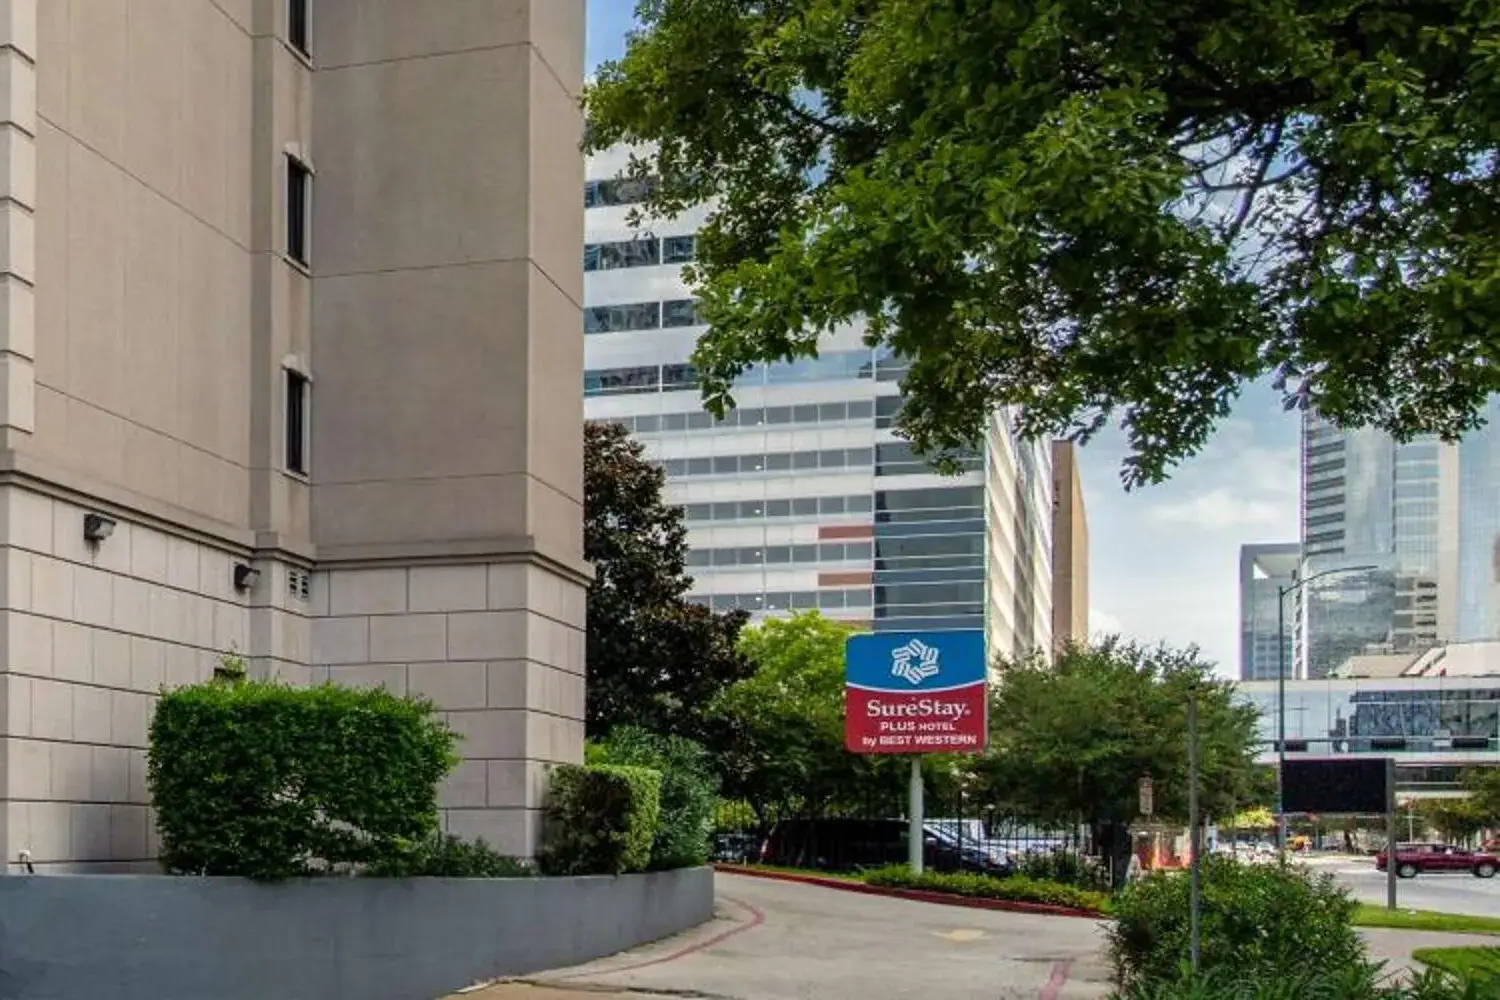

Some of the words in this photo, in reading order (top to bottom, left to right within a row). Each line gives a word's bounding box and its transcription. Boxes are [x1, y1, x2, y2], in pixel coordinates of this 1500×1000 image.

[867, 699, 966, 721] SureStay
[880, 721, 917, 731] PLUS
[918, 722, 956, 731] HOTEL
[862, 736, 878, 747] by
[879, 735, 912, 745] BEST
[914, 735, 977, 745] WESTERN
